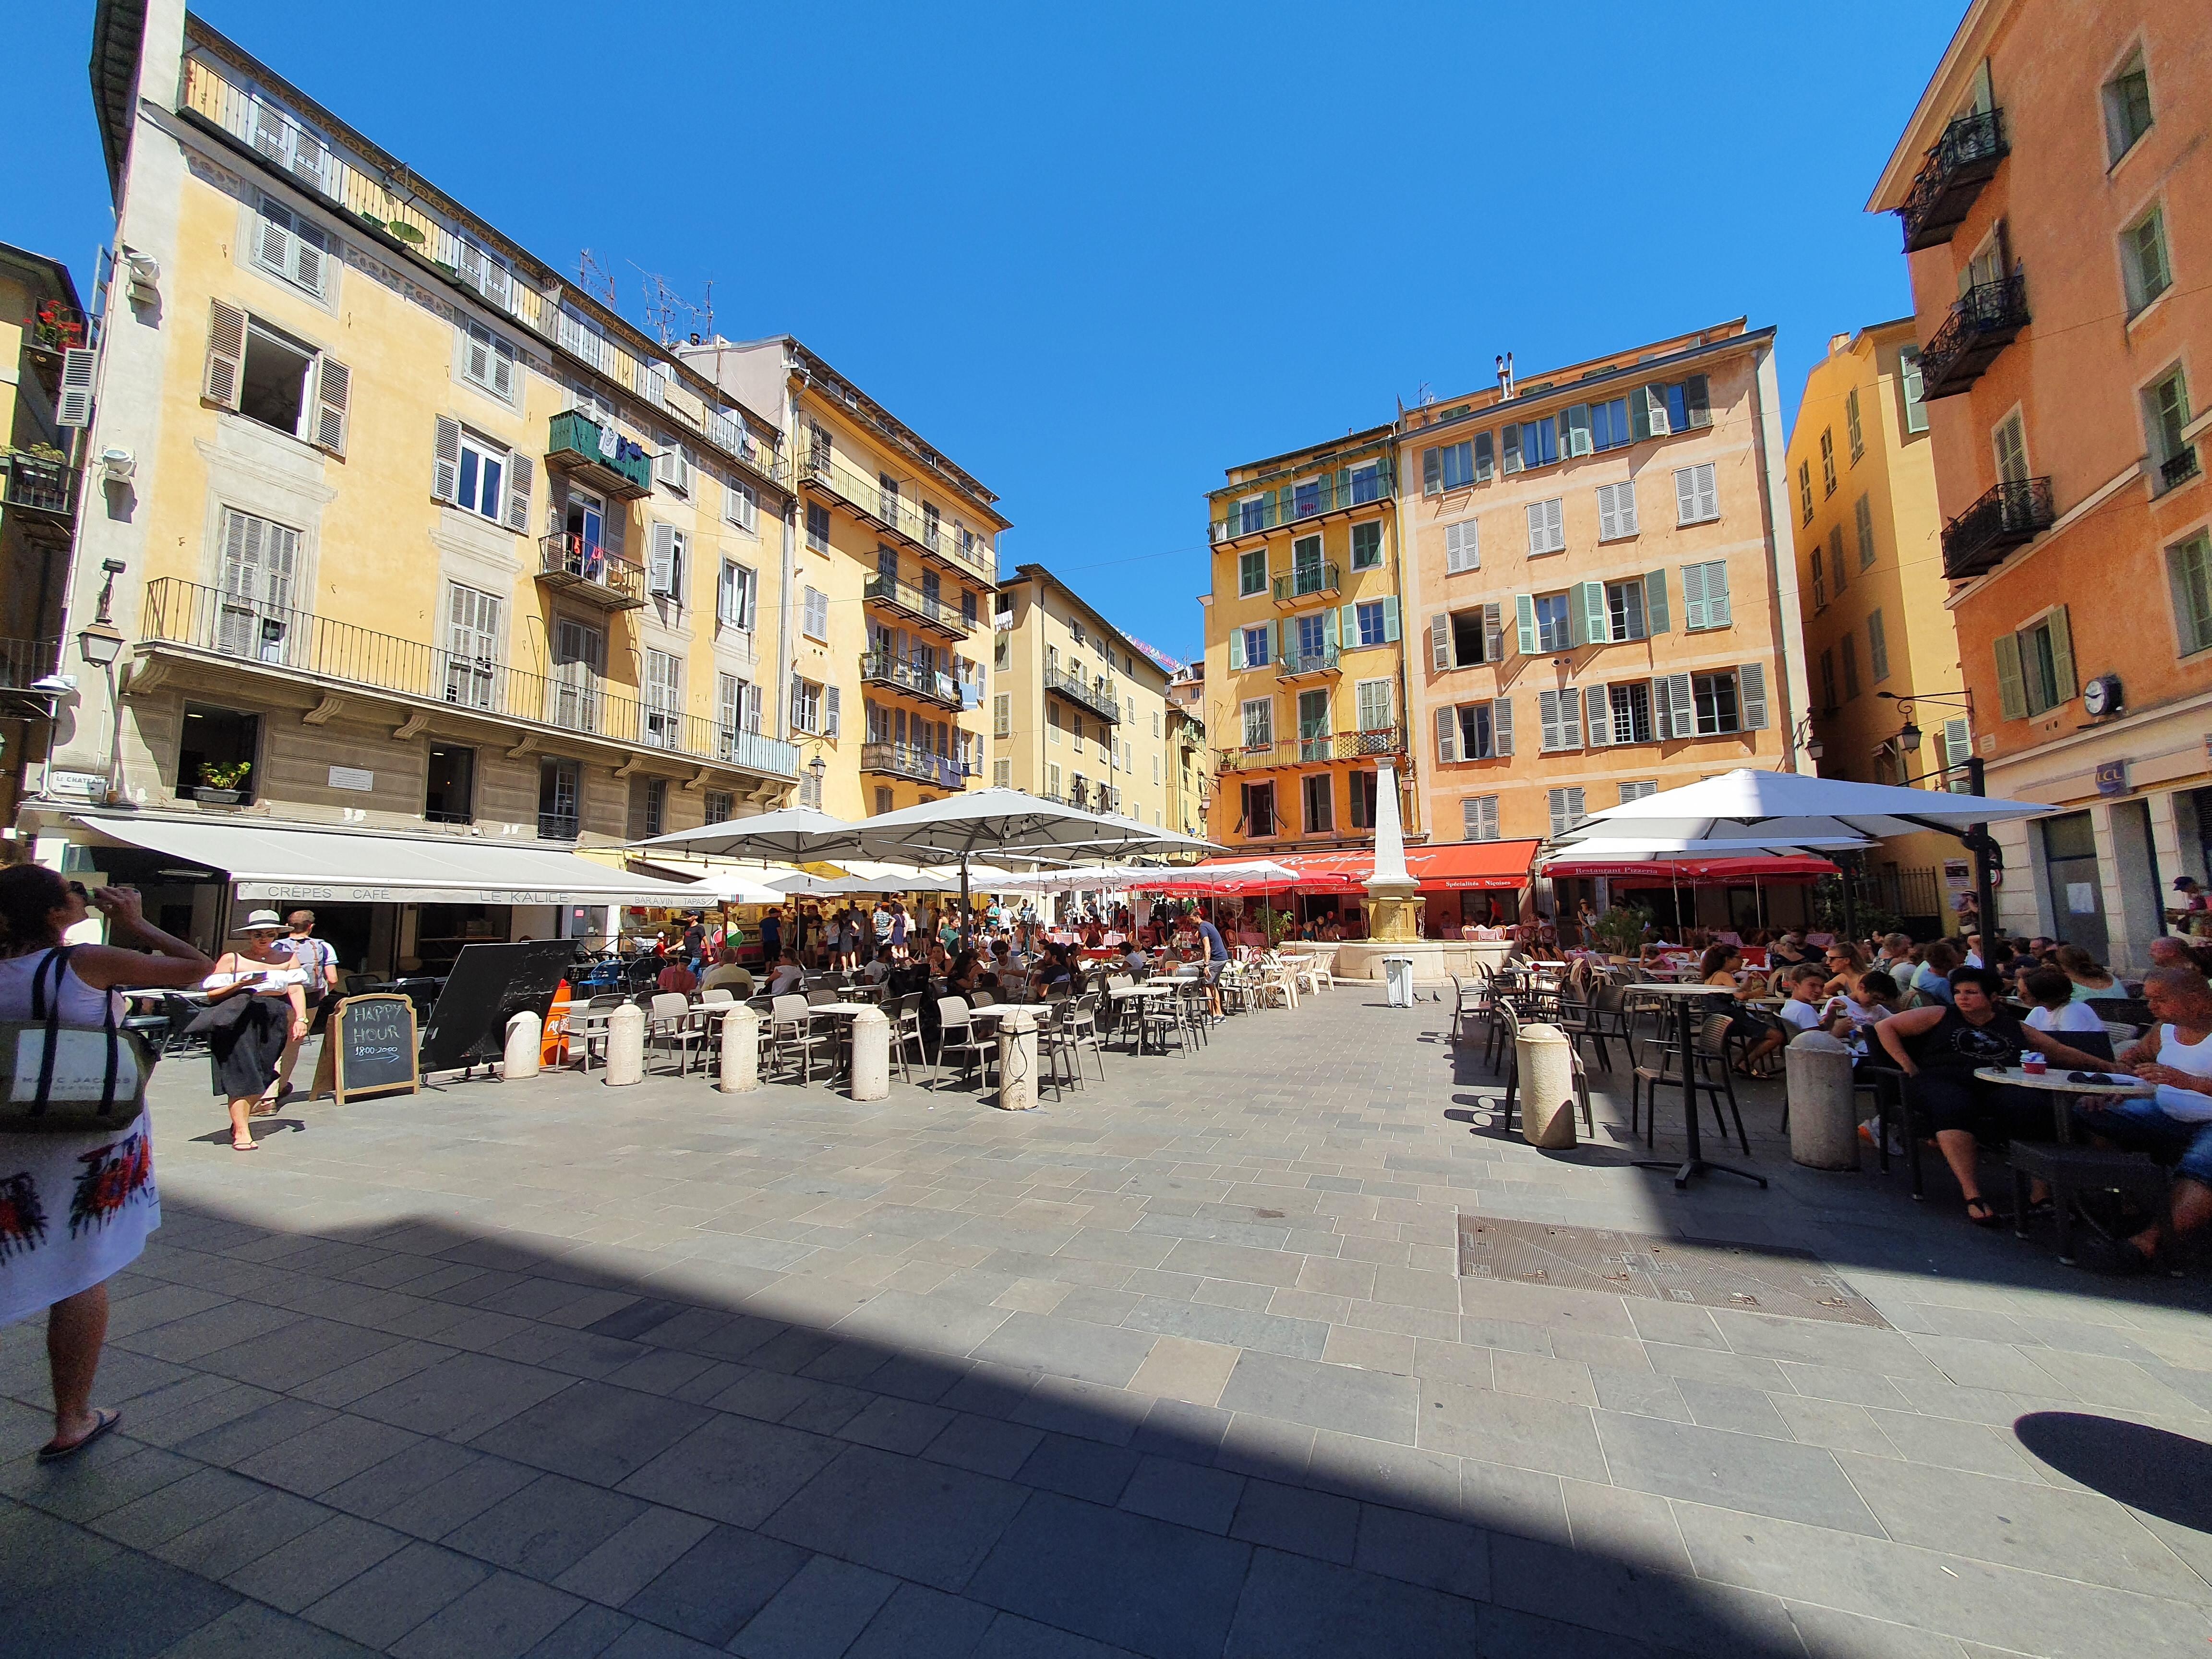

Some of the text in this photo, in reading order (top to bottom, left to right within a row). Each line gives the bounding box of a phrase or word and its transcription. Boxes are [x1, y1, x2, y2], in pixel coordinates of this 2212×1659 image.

[2097, 769, 2122, 782] LCL
[1271, 854, 1437, 866] Restaurnt
[268, 886, 390, 900] CRÊPES CAFÉ
[480, 891, 568, 902] LE KALICE
[355, 1004, 402, 1022] HAPPY
[354, 1024, 400, 1044] HOUR
